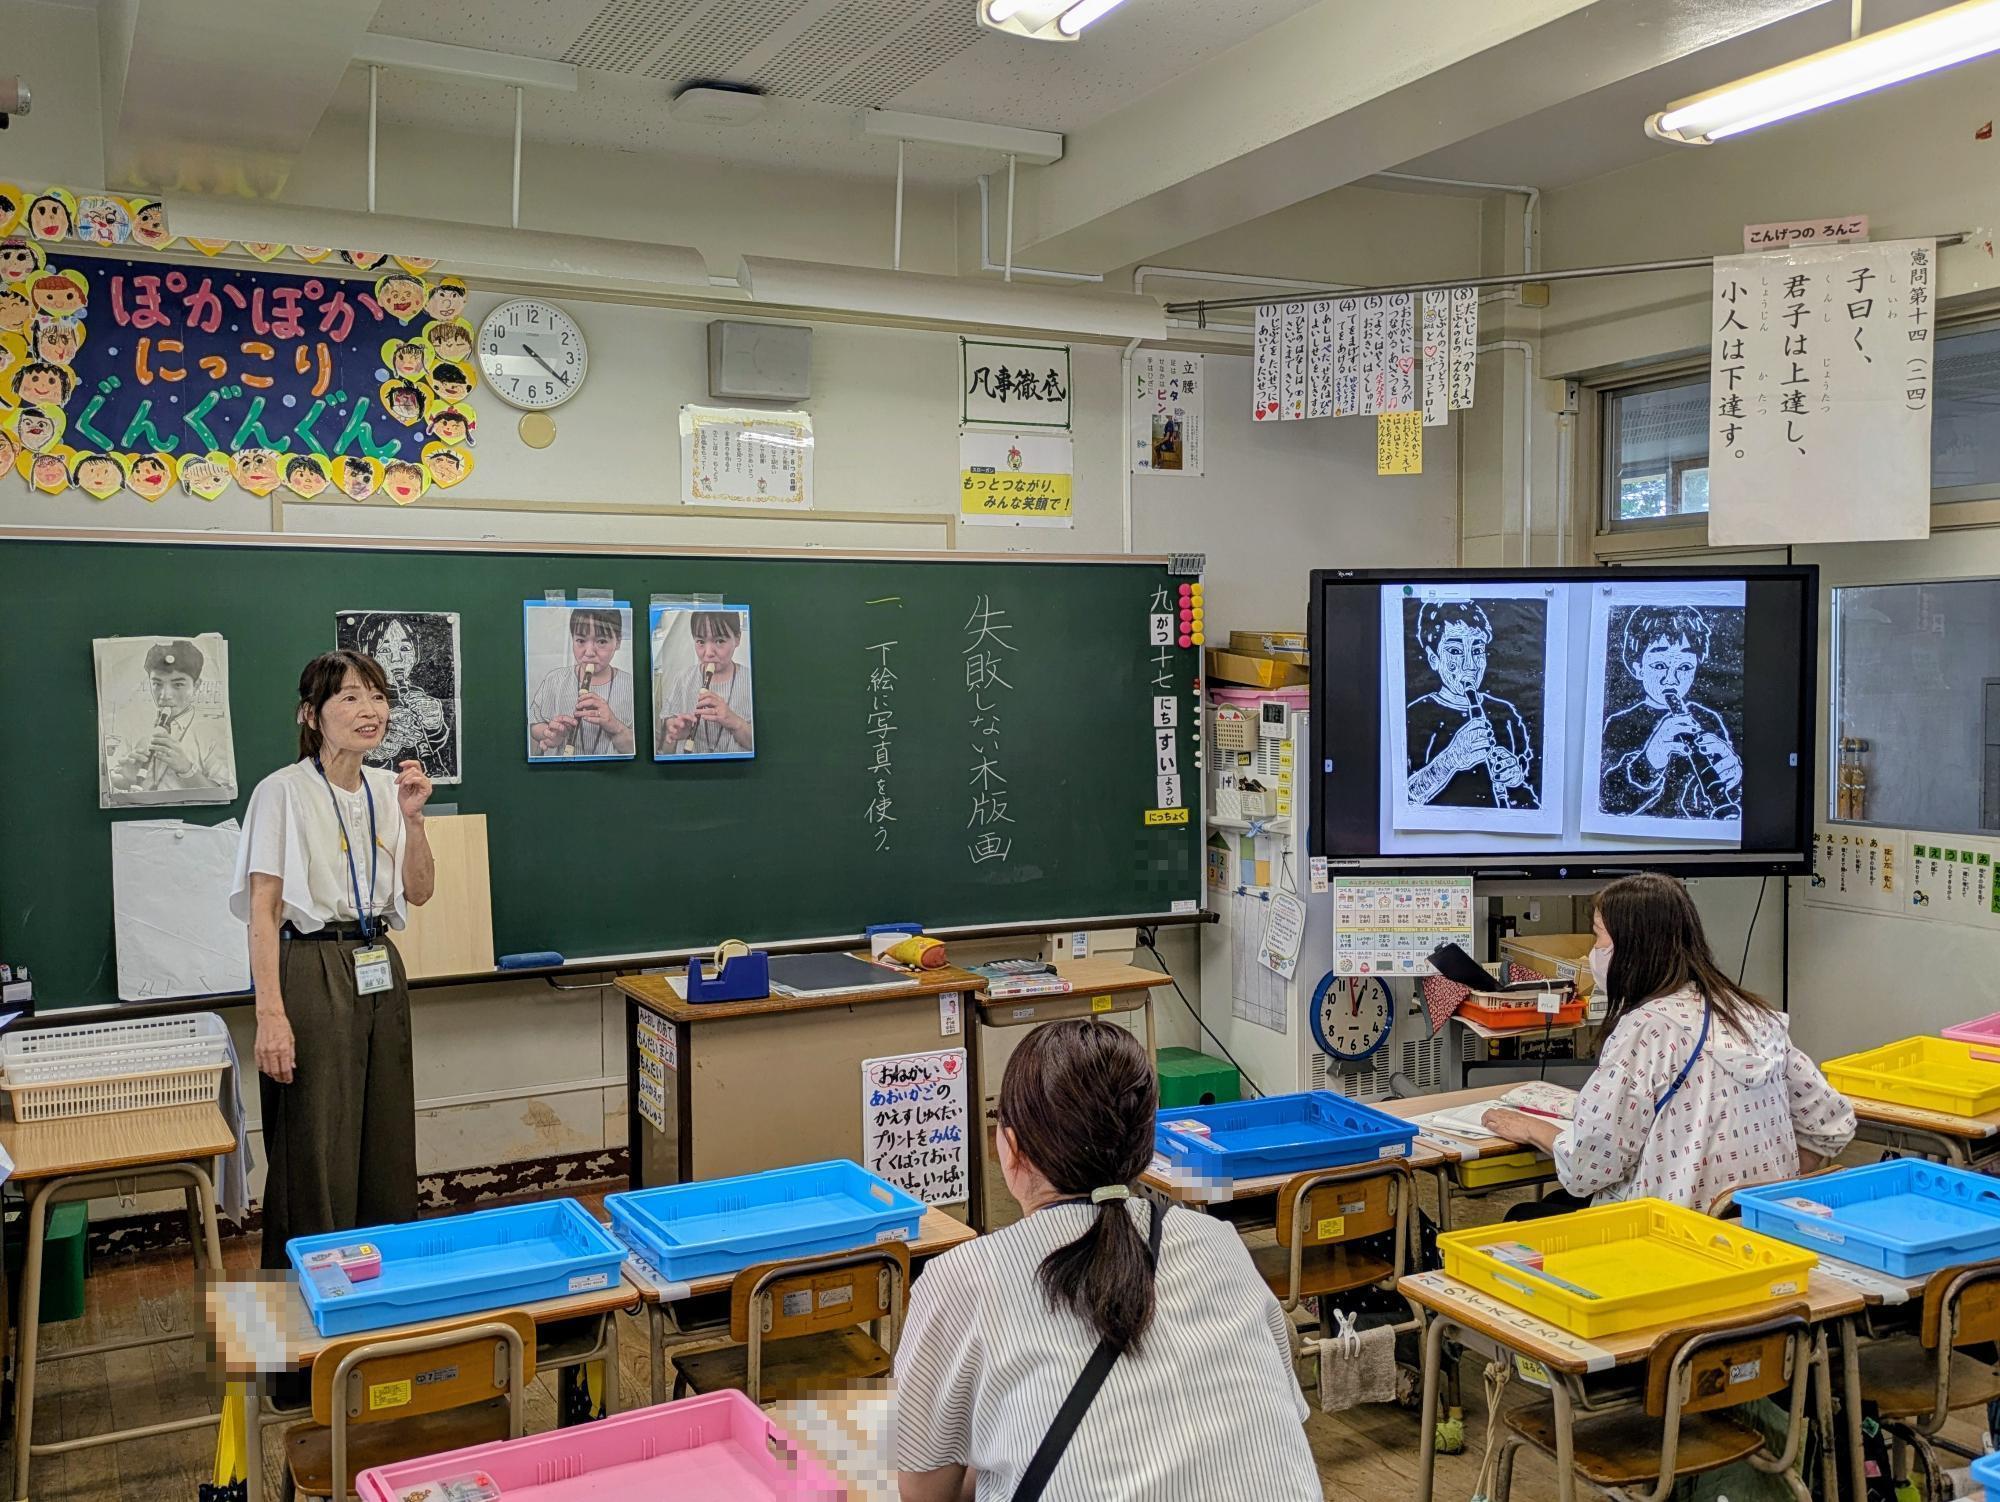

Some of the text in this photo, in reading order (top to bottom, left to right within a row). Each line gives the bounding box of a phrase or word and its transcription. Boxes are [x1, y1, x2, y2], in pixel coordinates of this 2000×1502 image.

[1750, 221, 1861, 243] こんげつの ろんご
[111, 272, 384, 342] ぽかぽか
[510, 313, 518, 326] 11
[528, 309, 539, 323] 12
[494, 325, 505, 338] 10
[561, 332, 569, 345] 2
[490, 343, 497, 355] 9
[566, 352, 574, 364] 3
[1780, 274, 1812, 455] 君子は上達し、
[136, 338, 332, 396] にっこり
[495, 363, 503, 376] 8
[1718, 281, 1748, 459] 小人は下達す。
[560, 370, 569, 383] 4
[1182, 361, 1194, 394] 立腰
[511, 378, 519, 392] 7
[546, 382, 553, 395] 5
[969, 365, 1066, 403] 凡事徹底
[529, 385, 536, 398] 6
[75, 376, 401, 455] ぐんぐんぐん
[964, 477, 1056, 493] もっとつながり、
[962, 595, 1019, 864] 失敗しない木版画
[1149, 812, 1184, 821] にっちょく
[1211, 854, 1215, 862] 1
[1219, 856, 1224, 865] 2
[1210, 868, 1215, 878] 3
[1219, 870, 1223, 879] 4
[1339, 980, 1345, 991] 11
[1328, 993, 1336, 1004] 10
[1372, 988, 1378, 1000] 2
[1326, 1009, 1331, 1020] 9
[1377, 1005, 1383, 1016] 3
[1329, 1025, 1334, 1036] 8
[1373, 1022, 1379, 1033] 4
[1338, 1037, 1344, 1048] 7
[1351, 1039, 1356, 1050] 6
[1364, 1035, 1369, 1046] 5
[660, 1044, 674, 1065] まとめ
[641, 1054, 662, 1080] もんだい
